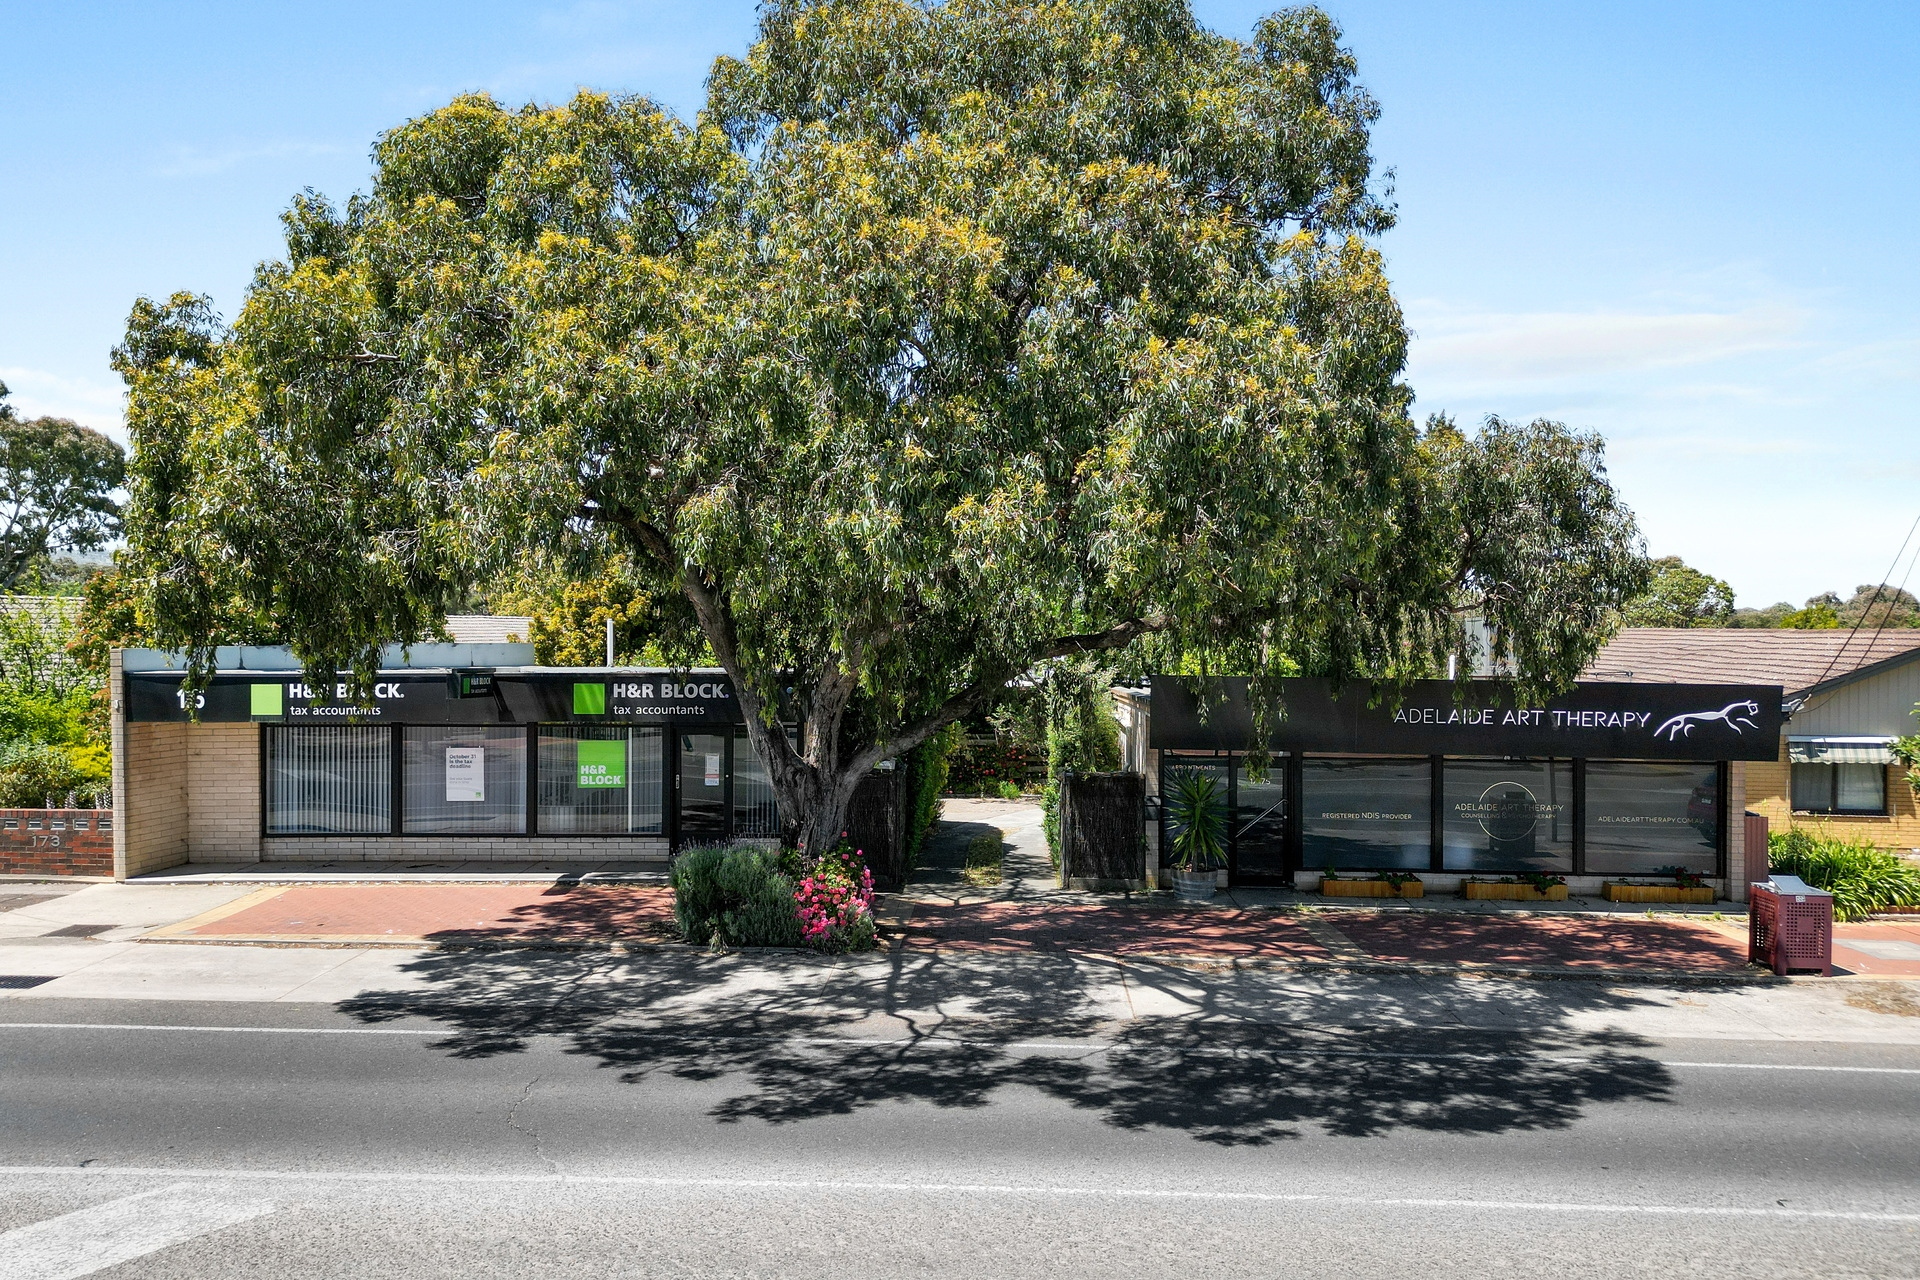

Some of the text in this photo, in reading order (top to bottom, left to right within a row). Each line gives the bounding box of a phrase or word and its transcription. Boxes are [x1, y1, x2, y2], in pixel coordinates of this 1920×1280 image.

[289, 683, 330, 698] H&
[613, 683, 654, 698] H&R
[290, 706, 381, 716] tax accountants
[613, 705, 705, 716] tax accountants
[1393, 708, 1651, 728] ADELAIDE ART THERAPY
[580, 765, 607, 774] H&R
[580, 775, 622, 785] BLOCK
[1454, 803, 1498, 811] ADELAIDE
[1523, 804, 1565, 812] THERAPY
[1361, 812, 1380, 820] NDIS
[32, 835, 60, 847] 173
